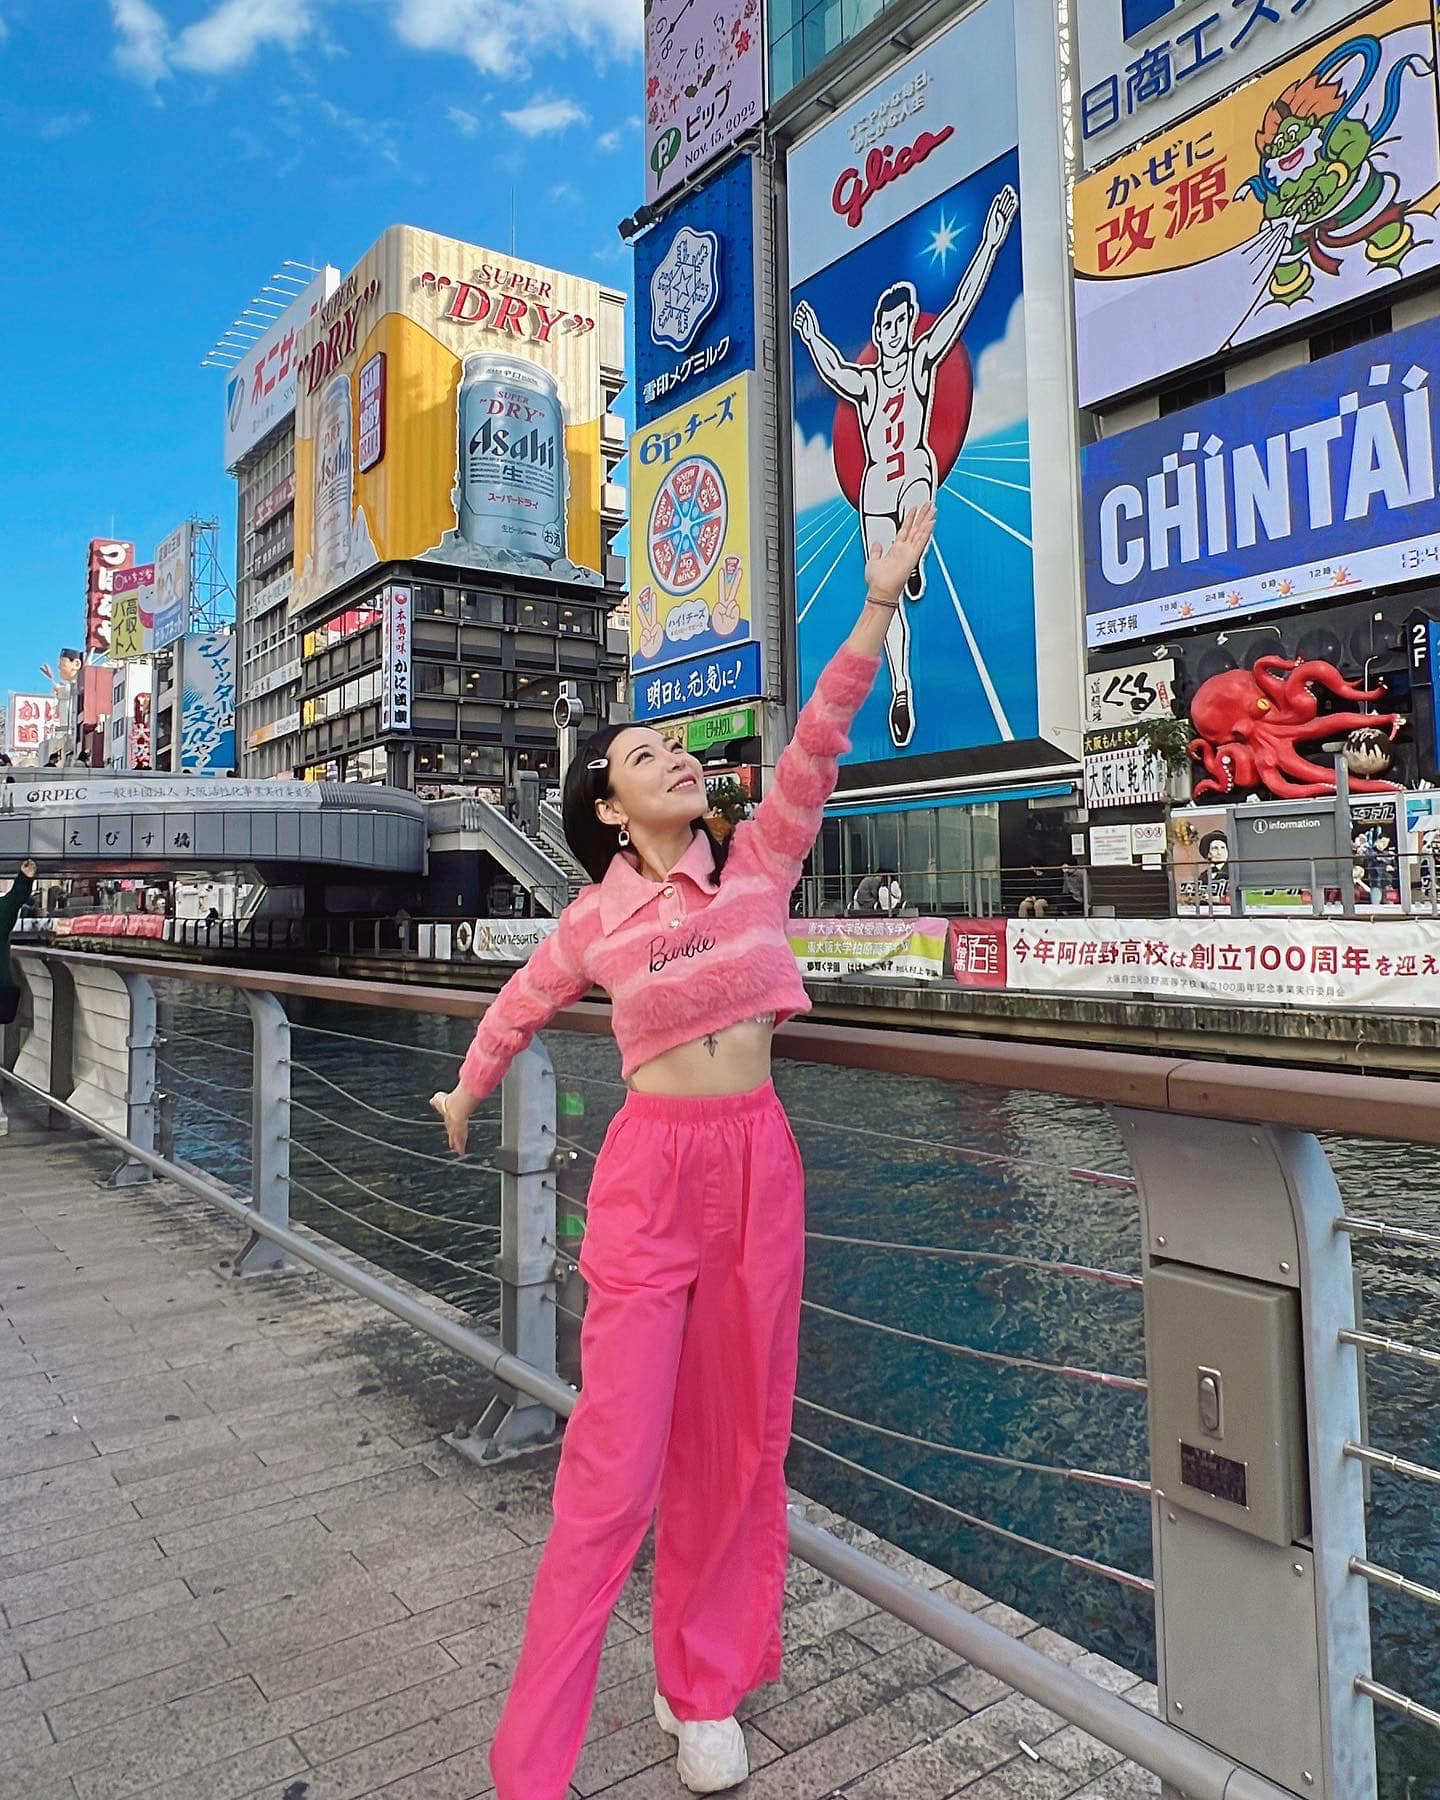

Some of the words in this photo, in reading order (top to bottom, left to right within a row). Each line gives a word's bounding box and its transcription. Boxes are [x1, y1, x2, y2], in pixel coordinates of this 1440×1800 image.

[1081, 0, 1307, 140] 日商エス
[686, 80, 732, 143] ピップ
[726, 101, 756, 133] 2022
[831, 125, 955, 228] Glico
[1106, 132, 1215, 209] かぜに
[1095, 154, 1231, 272] 改源
[320, 275, 357, 330] SUPER
[479, 263, 552, 298] SUPER
[643, 336, 729, 403] 雪印メグミルク
[469, 417, 554, 470] Asahi
[882, 385, 906, 482] グリコ
[487, 492, 538, 509] スーパードライ
[502, 465, 523, 484] 生
[113, 601, 124, 656] バイト
[126, 597, 137, 653] 高収入
[1096, 613, 1138, 638] 天気予報
[1269, 819, 1321, 830] information
[649, 928, 716, 973] Barbie
